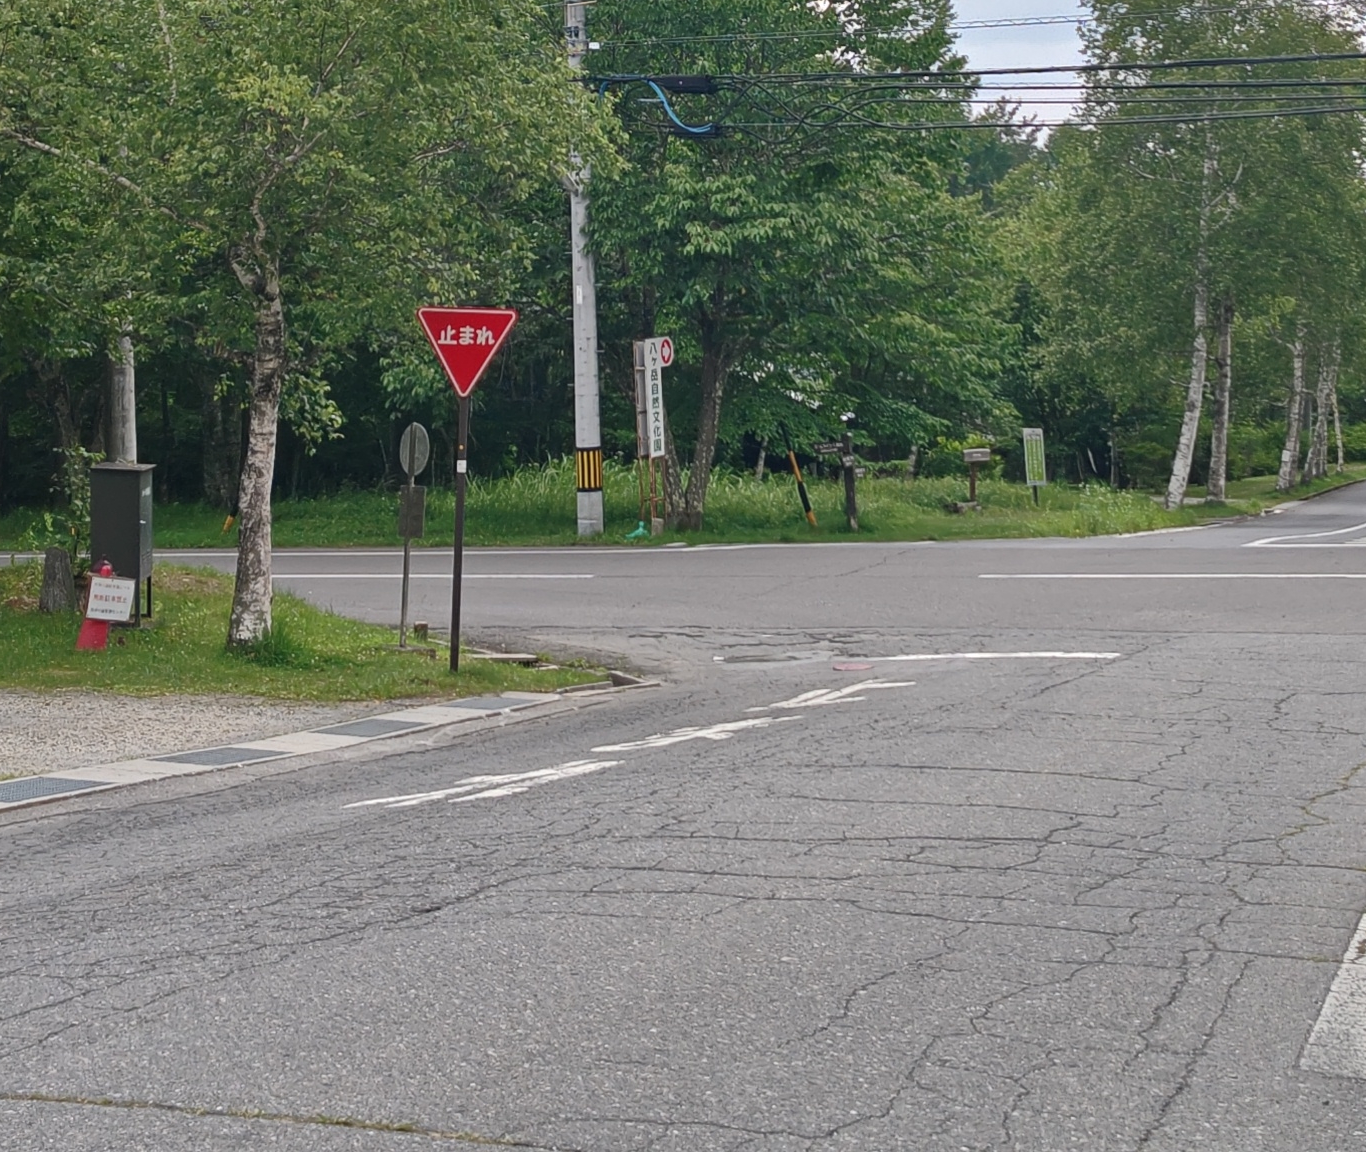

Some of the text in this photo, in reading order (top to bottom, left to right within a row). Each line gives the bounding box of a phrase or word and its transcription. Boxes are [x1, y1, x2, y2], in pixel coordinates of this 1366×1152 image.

[437, 325, 495, 346] 止まれ
[341, 679, 916, 808] 止まれ
